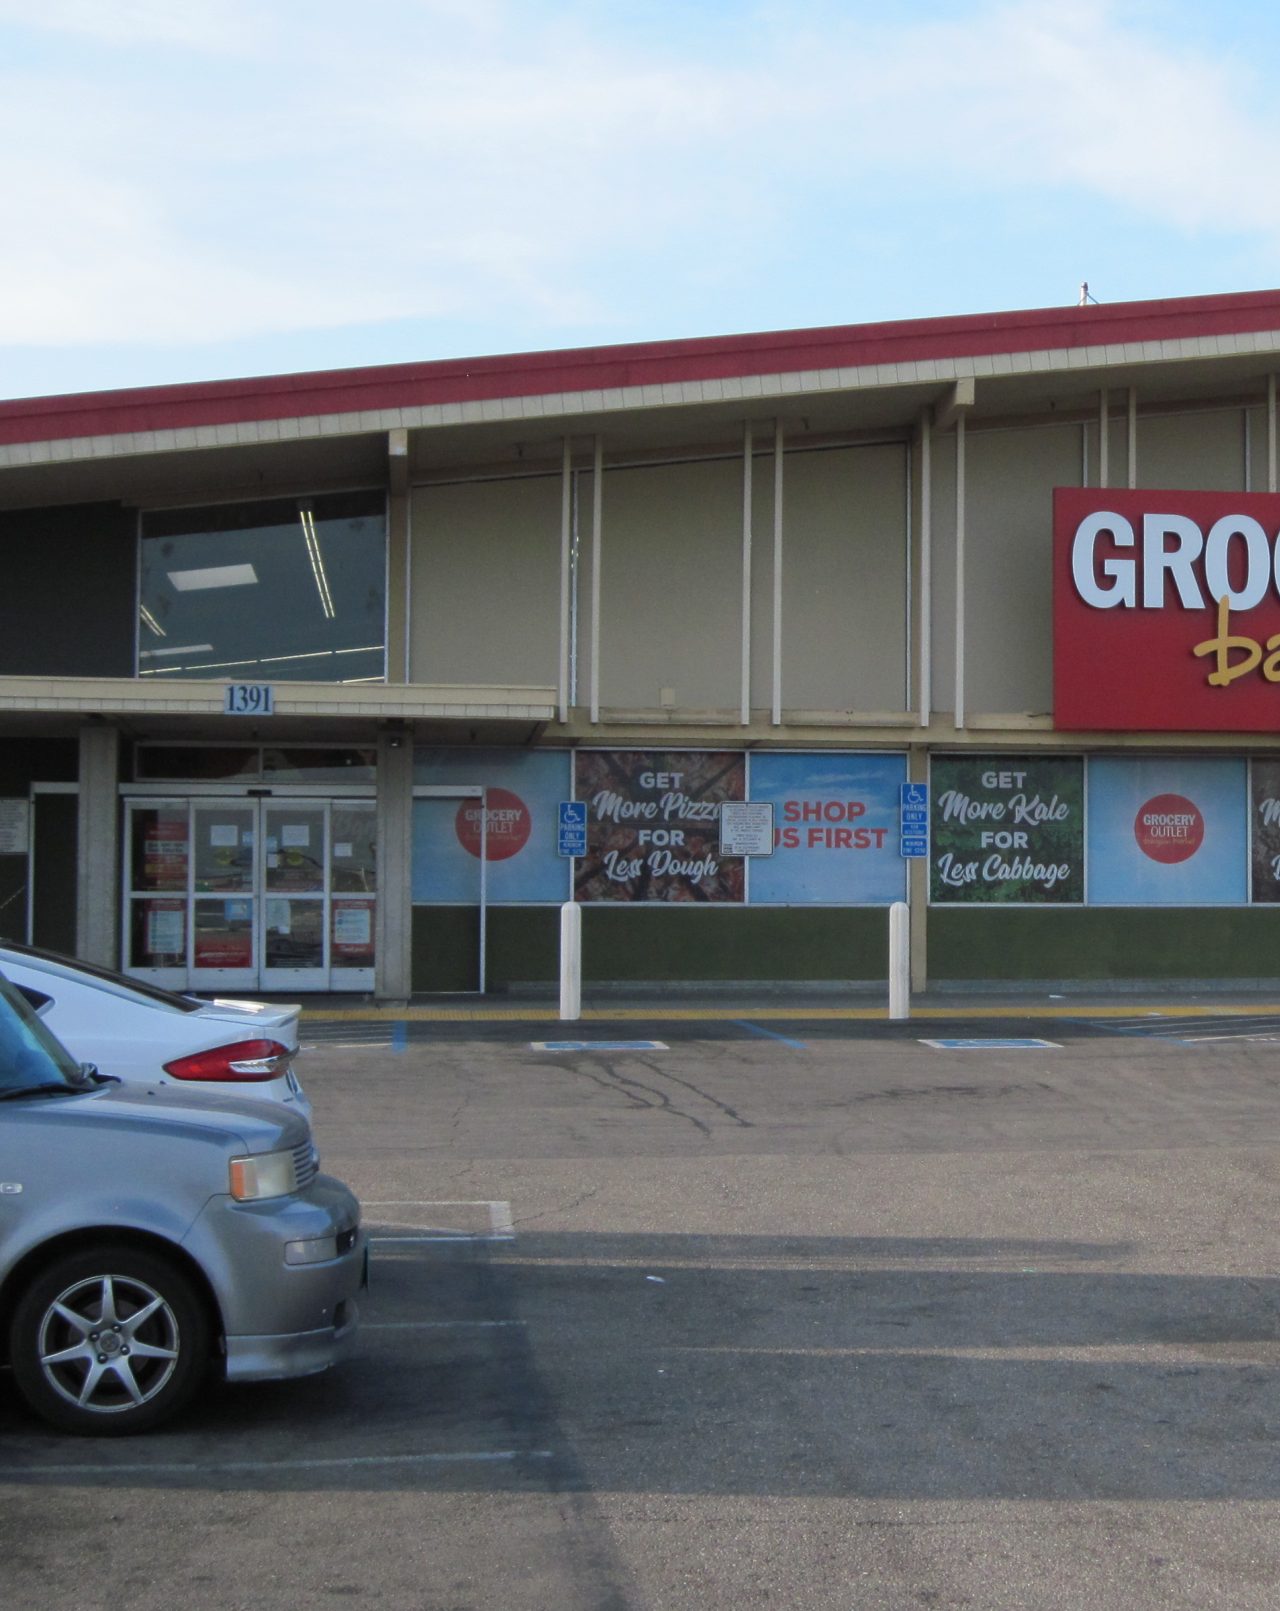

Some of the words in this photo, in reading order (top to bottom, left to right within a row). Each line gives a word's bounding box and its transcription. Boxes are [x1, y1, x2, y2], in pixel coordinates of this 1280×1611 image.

[228, 685, 270, 712] 1391
[640, 772, 684, 789] GET
[981, 771, 1027, 789] GET
[592, 790, 658, 823] More
[784, 800, 866, 823] SHOP
[937, 790, 1006, 825] More
[1007, 793, 1070, 826] Kale
[1143, 814, 1195, 826] GROCERY
[638, 829, 685, 846] FOR
[807, 828, 889, 849] FIRST
[981, 831, 1028, 849] FOR
[1150, 825, 1188, 837] OUTLET
[604, 850, 644, 882] Less
[647, 850, 718, 884] Dough
[938, 852, 979, 887] Less
[982, 853, 1071, 889] Cabbage
